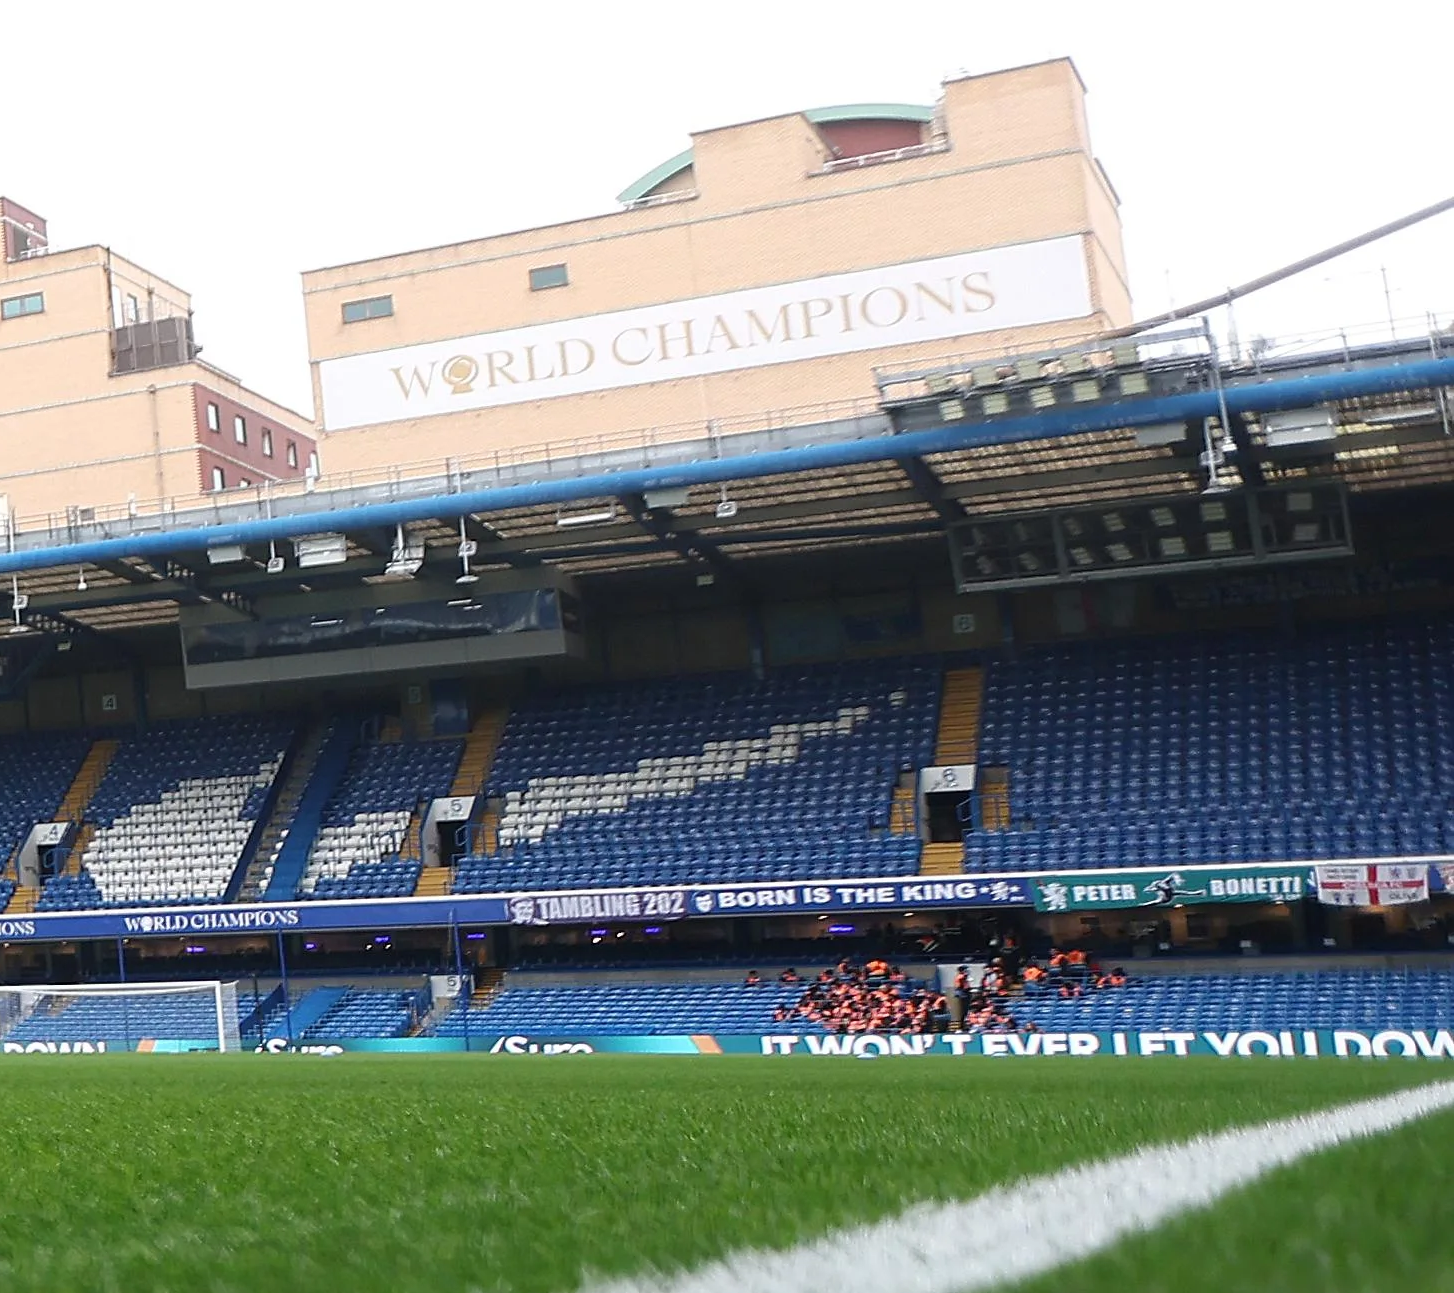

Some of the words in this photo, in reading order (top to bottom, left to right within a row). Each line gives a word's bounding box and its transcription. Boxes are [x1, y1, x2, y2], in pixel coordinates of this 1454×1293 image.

[611, 270, 997, 368] CHAMPIONS
[450, 799, 463, 814] 5
[50, 825, 59, 839] 4
[718, 888, 797, 909] BORN
[802, 886, 831, 905] IS
[836, 885, 895, 905] THE
[902, 882, 977, 903] KING
[1073, 884, 1136, 902] PETER
[1210, 876, 1302, 896] BONETTI
[537, 893, 641, 919] TAMBLING
[643, 891, 685, 916] 202
[190, 909, 299, 928] CHAMPIONS
[446, 977, 457, 987] 5
[760, 1034, 799, 1055] IT
[981, 1032, 1100, 1056] EVER
[1202, 1030, 1319, 1056] YOU
